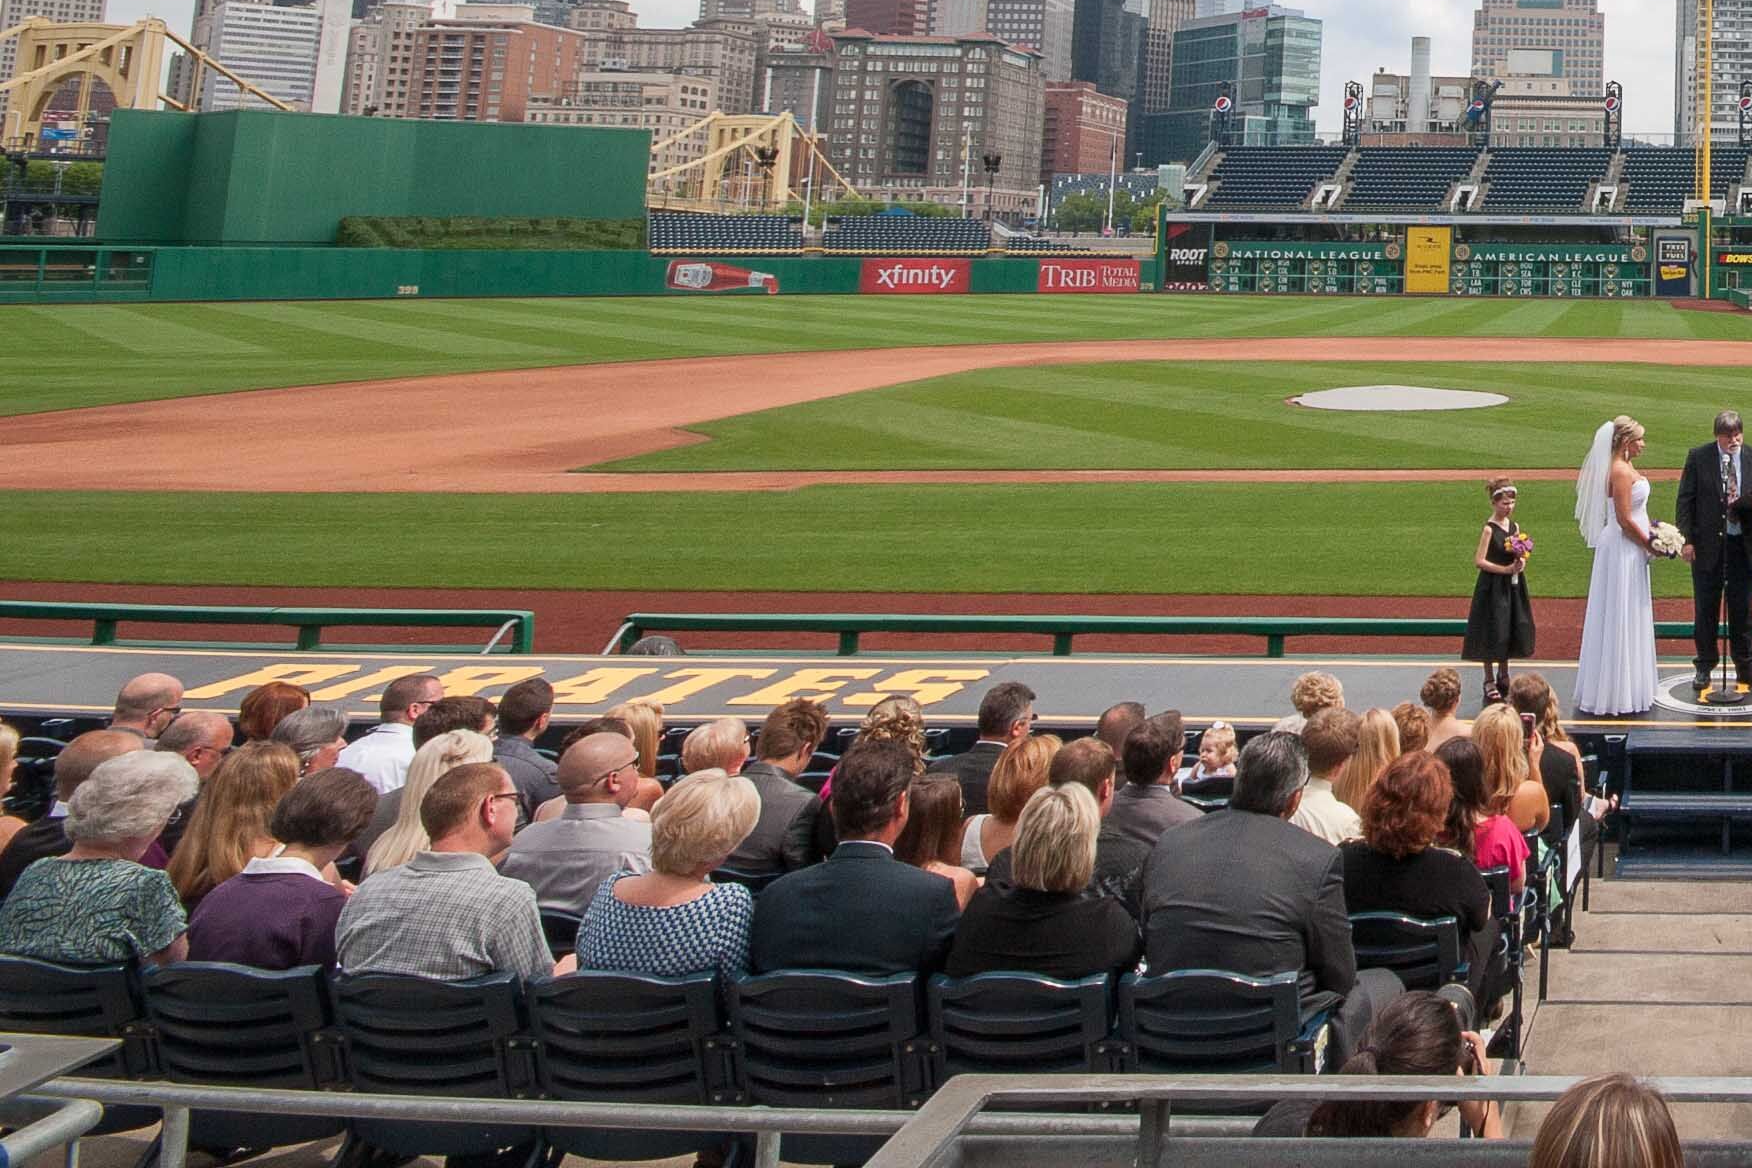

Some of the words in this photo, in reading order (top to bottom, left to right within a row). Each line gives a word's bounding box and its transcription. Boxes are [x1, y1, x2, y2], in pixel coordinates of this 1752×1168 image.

[1170, 248, 1208, 260] ROOT
[1232, 250, 1313, 259] NATIONAL
[1320, 250, 1384, 260] LEAGUE
[1473, 252, 1559, 262] AMERICAN
[1565, 253, 1629, 262] LEAGUE
[876, 264, 956, 289] xfinity
[1041, 265, 1096, 288] TRIB
[1101, 265, 1136, 277] TOTAL
[1102, 277, 1137, 288] MEDIA
[183, 663, 990, 706] PIRATES
